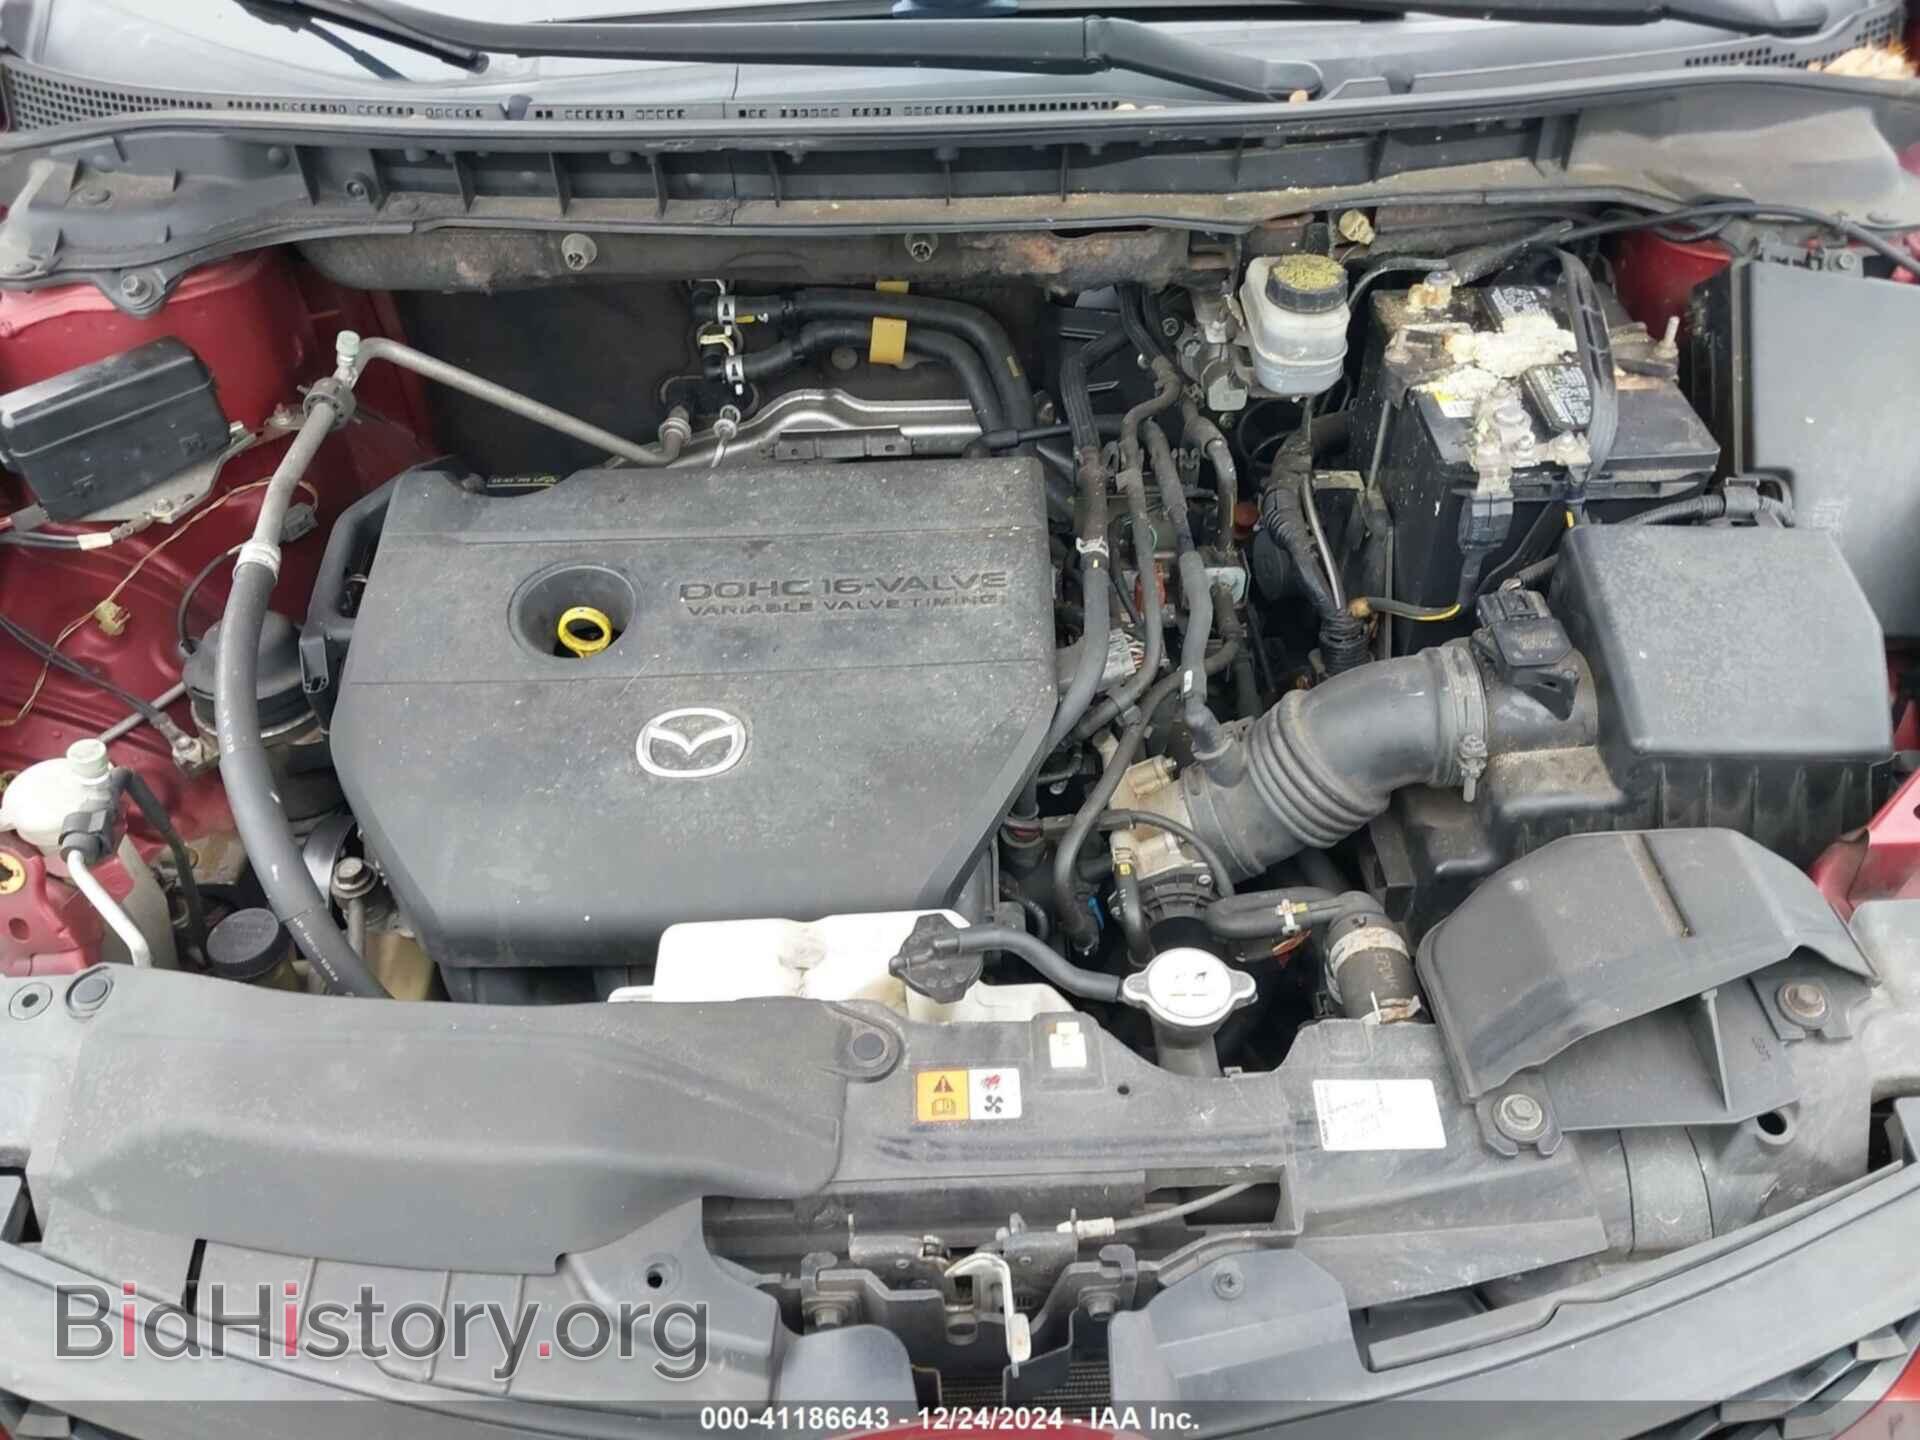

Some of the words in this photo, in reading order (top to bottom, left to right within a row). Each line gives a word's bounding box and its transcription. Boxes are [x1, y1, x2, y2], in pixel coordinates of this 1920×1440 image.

[679, 579, 812, 601] DOHC
[821, 571, 1007, 596] 16-VALVE
[687, 601, 814, 617] VARIABLE
[823, 599, 900, 611] VALVE
[911, 593, 999, 609] TIMING
